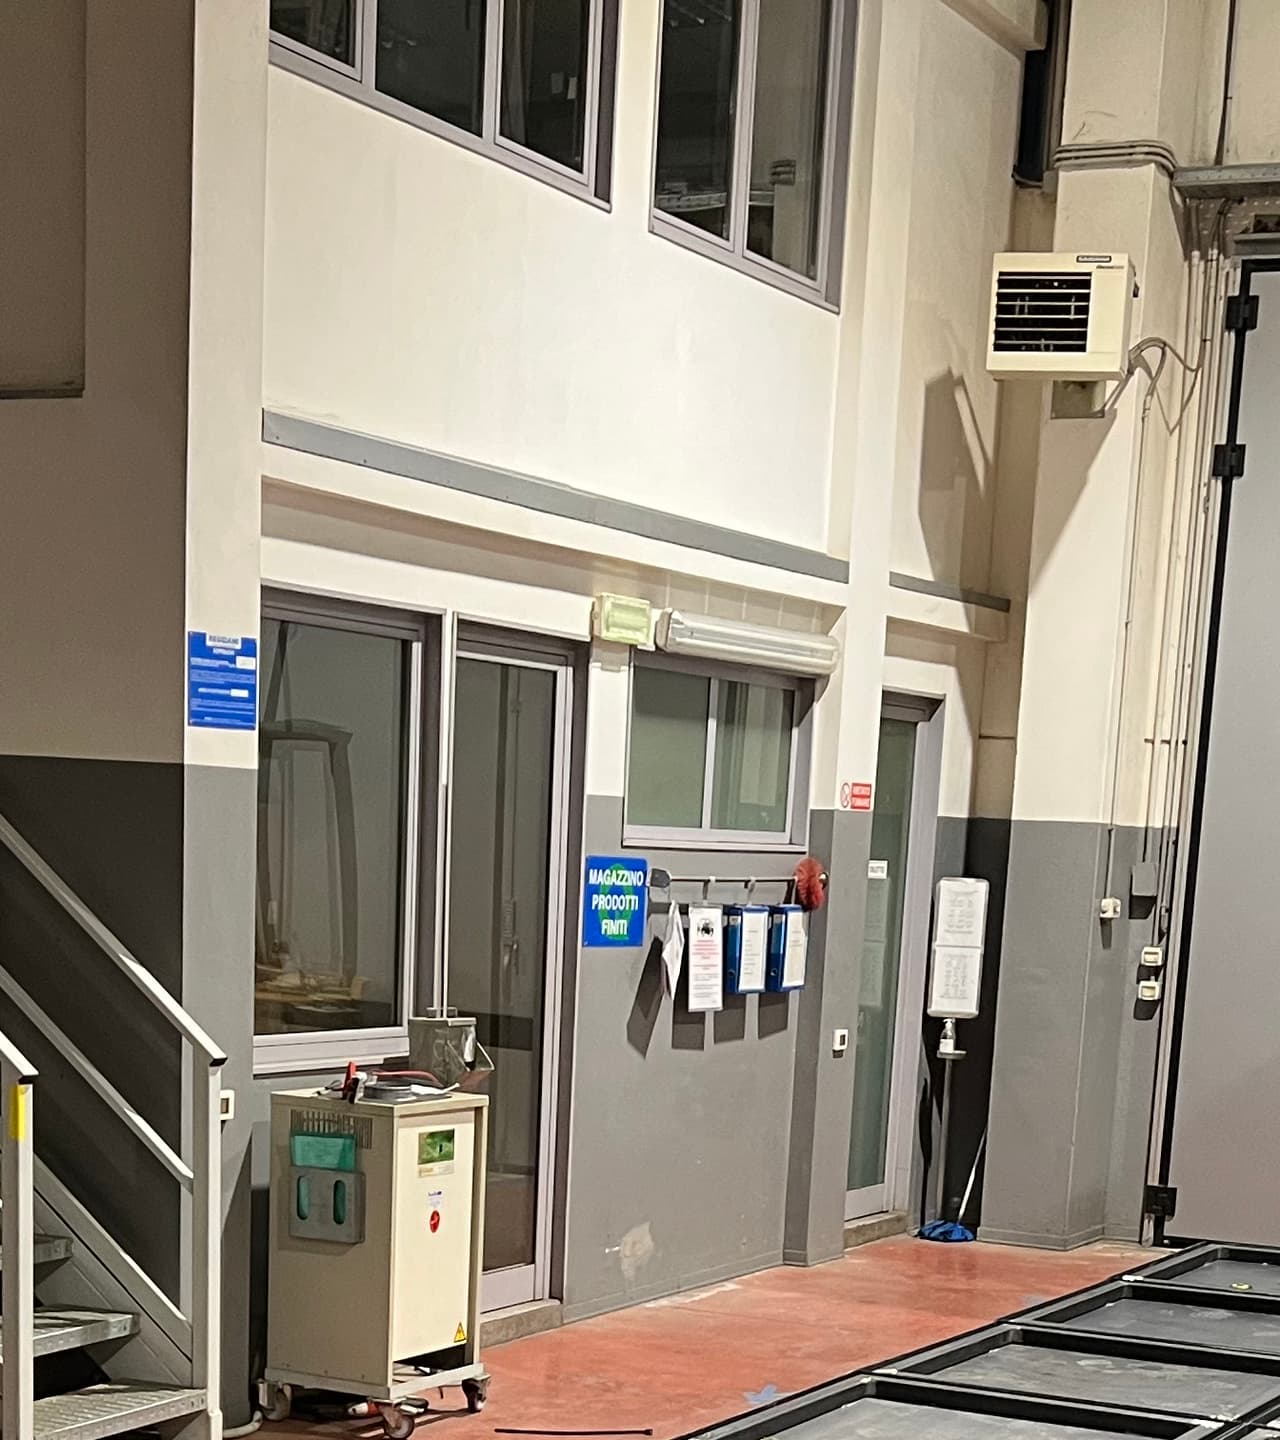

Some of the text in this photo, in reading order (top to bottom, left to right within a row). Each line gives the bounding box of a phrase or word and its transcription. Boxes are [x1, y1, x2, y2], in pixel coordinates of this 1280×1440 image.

[588, 868, 644, 887] MAGAZZINO
[591, 894, 639, 911] PRODOTTI
[601, 918, 628, 935] FINITI
